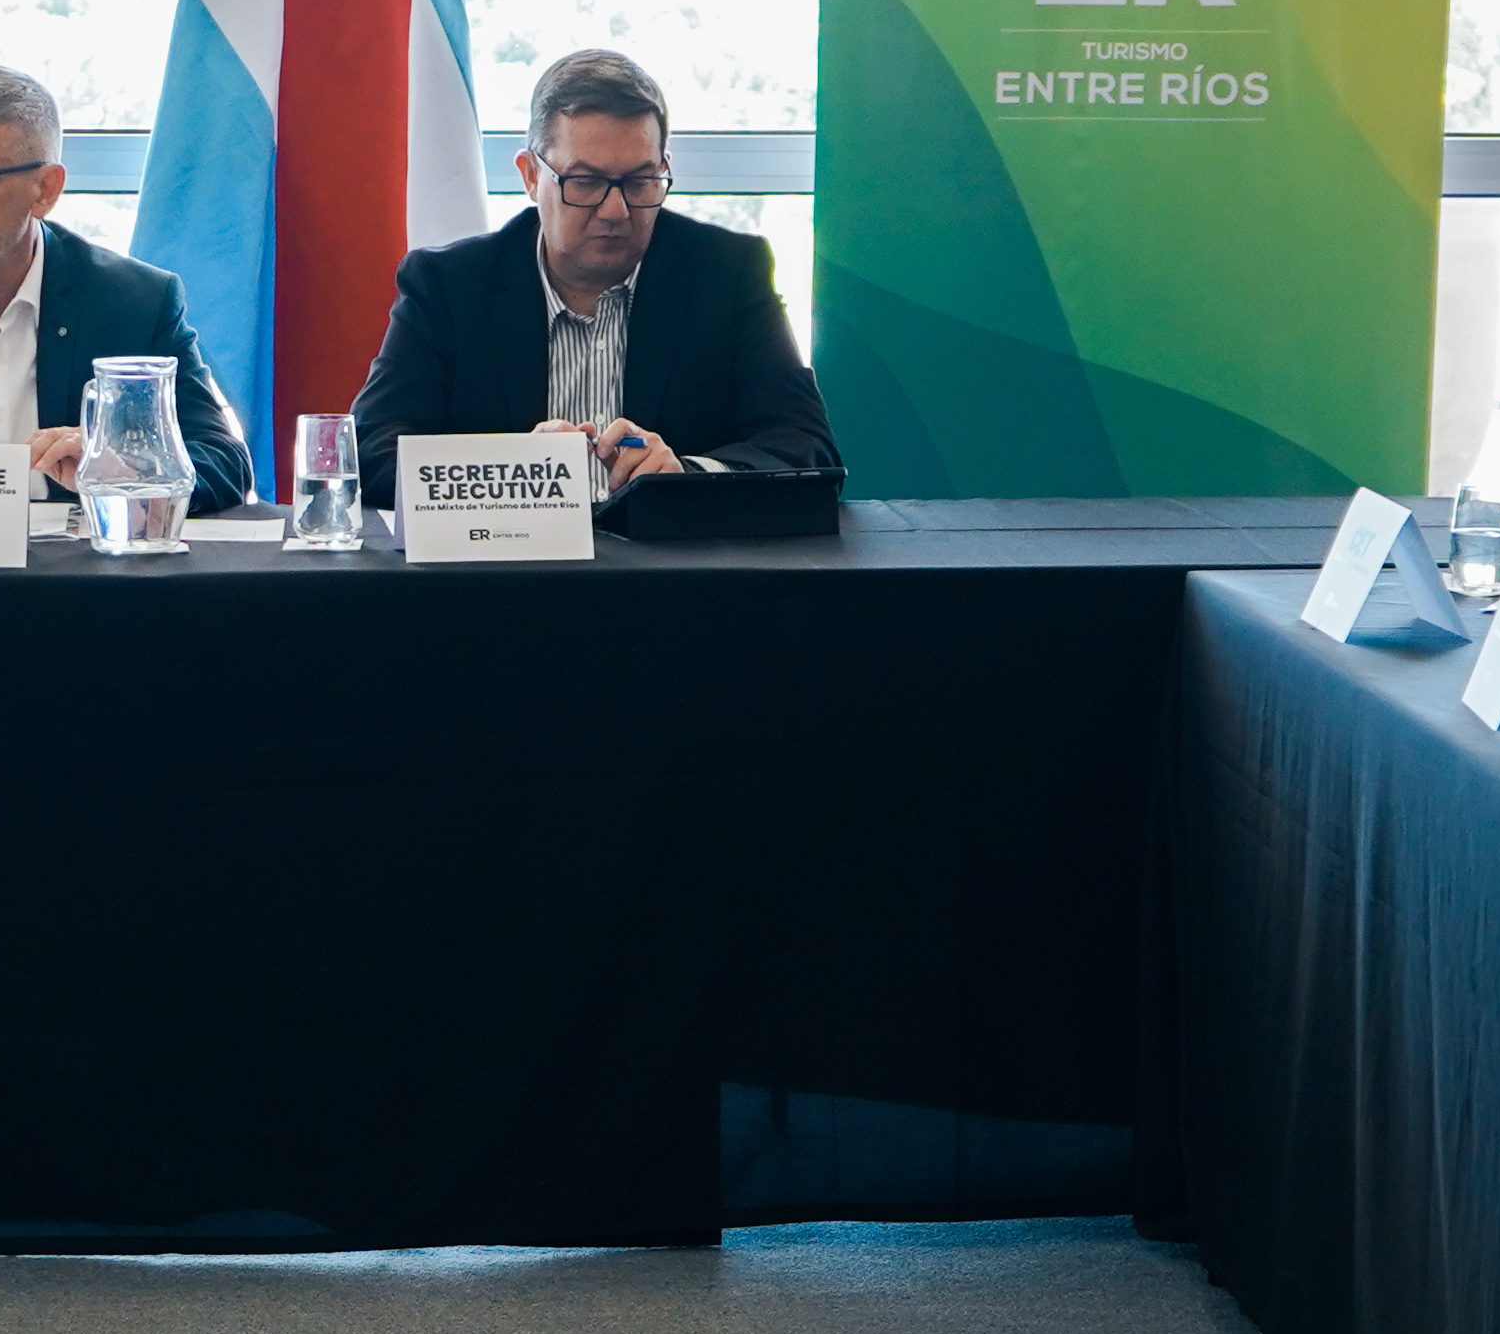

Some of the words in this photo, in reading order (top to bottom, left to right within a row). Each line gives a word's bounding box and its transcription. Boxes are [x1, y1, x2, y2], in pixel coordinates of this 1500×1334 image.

[1081, 41, 1188, 61] TURISMO
[995, 71, 1146, 104] ENTRE
[1160, 64, 1270, 106] RÍOS
[418, 456, 572, 482] SECRETARÍA
[428, 481, 565, 501] EJECUTIVA
[437, 502, 465, 511] Mixto
[466, 502, 478, 510] de
[479, 501, 519, 510] Turismo
[520, 501, 532, 510] de
[533, 501, 558, 509] Entre
[469, 529, 491, 541] ER
